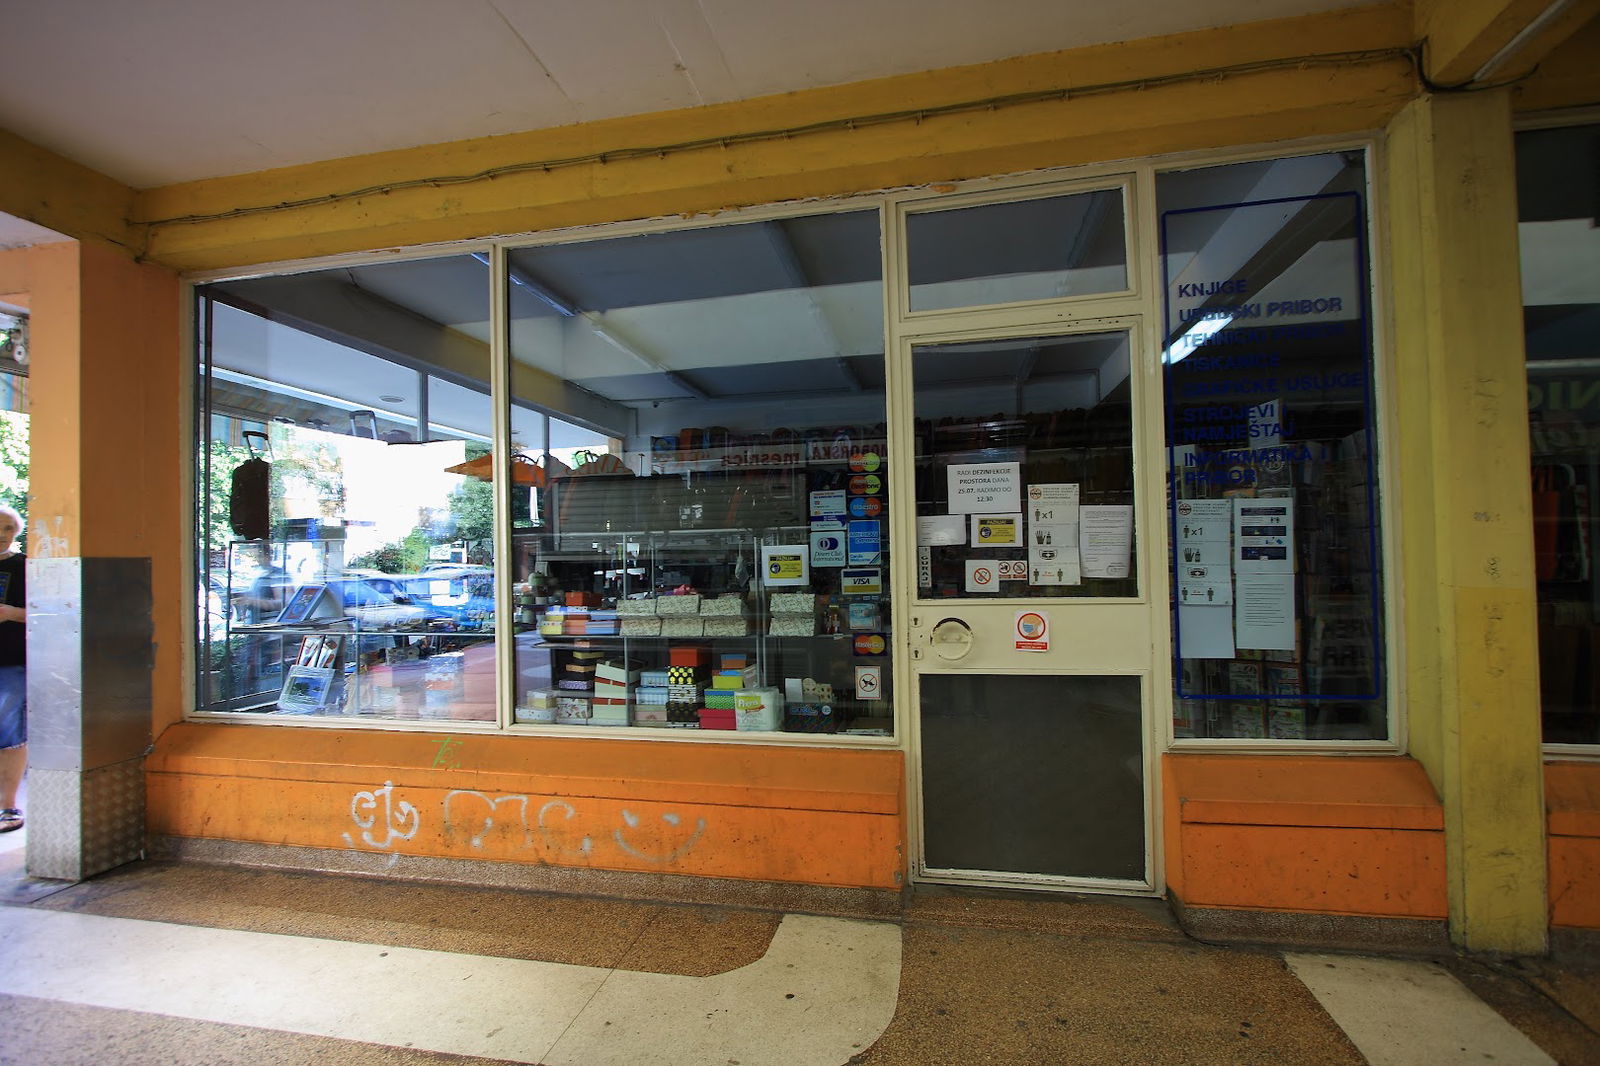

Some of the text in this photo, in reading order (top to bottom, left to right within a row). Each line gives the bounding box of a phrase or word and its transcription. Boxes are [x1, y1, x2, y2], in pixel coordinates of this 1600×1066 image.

[1178, 279, 1248, 298] KNJIGE
[1266, 297, 1343, 317] PRIBOR
[1183, 403, 1275, 422] STROJEVI
[1183, 420, 1296, 441] NAMJEŠTAJ
[1184, 445, 1313, 467] INFORMATIKA
[959, 477, 991, 485] PROSTORA
[1184, 468, 1258, 486] PRIBOR
